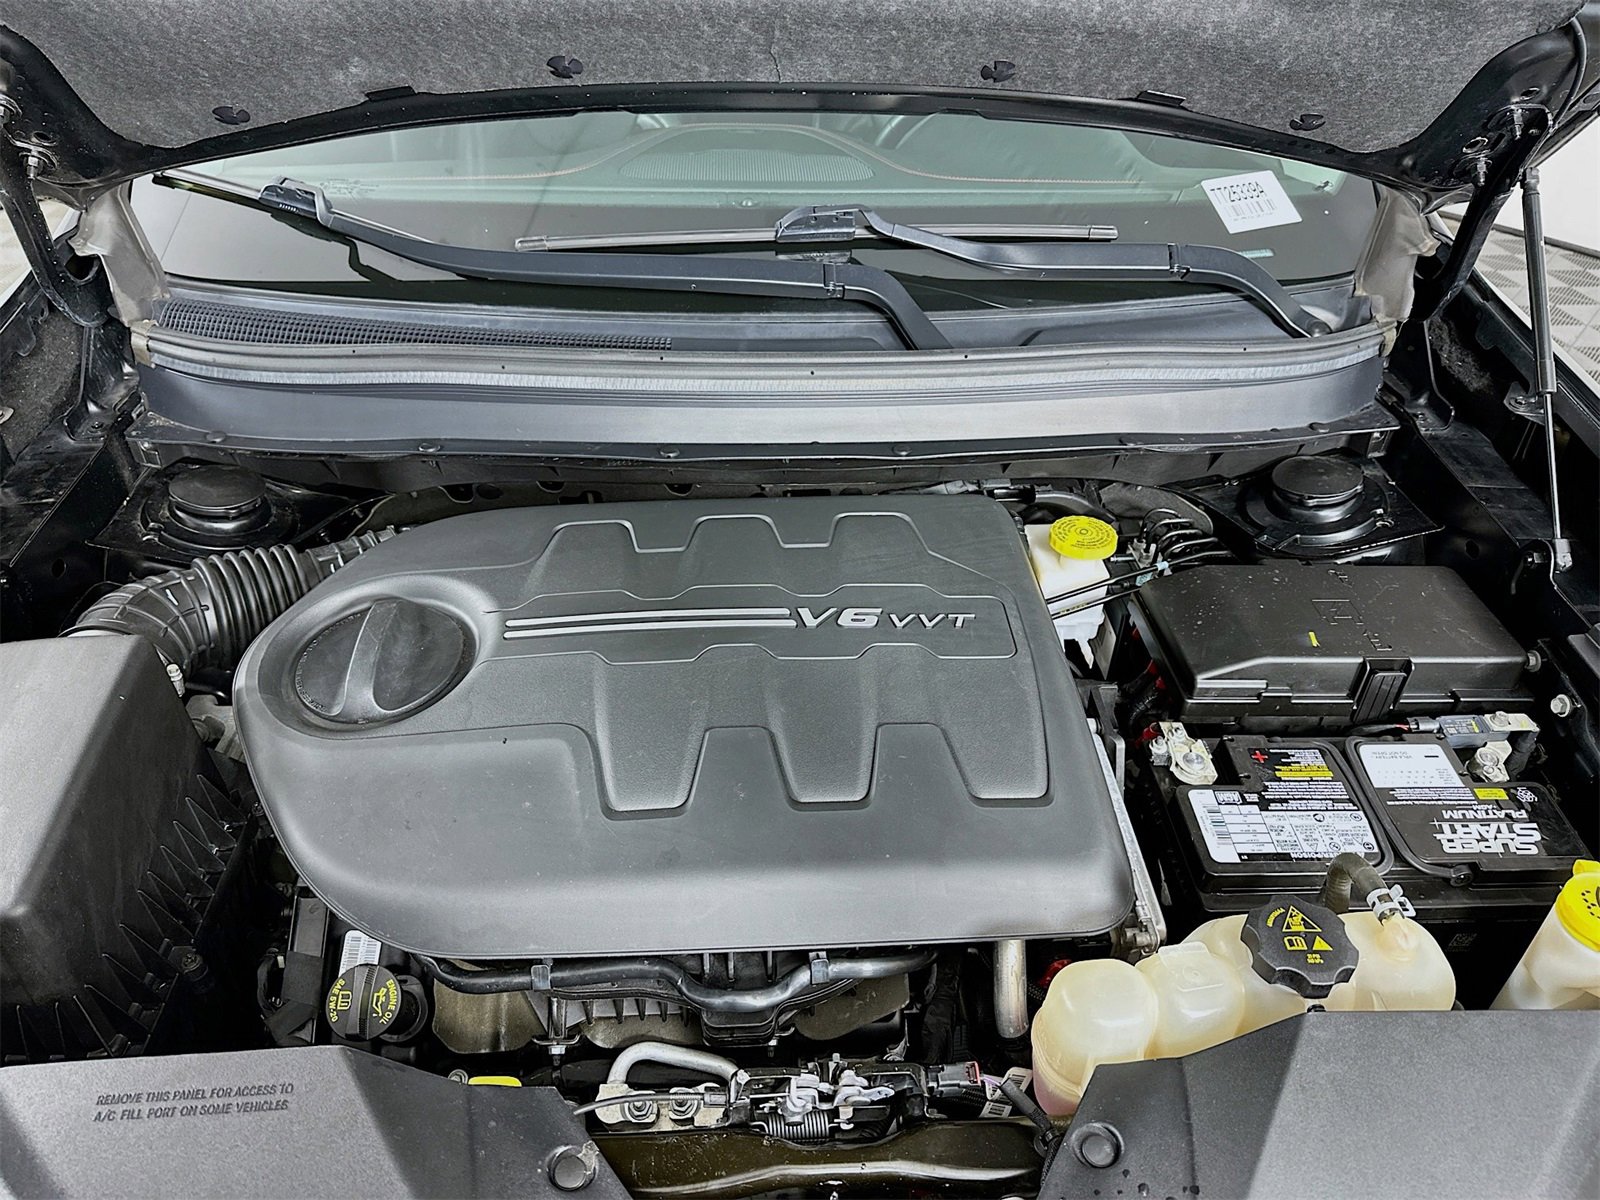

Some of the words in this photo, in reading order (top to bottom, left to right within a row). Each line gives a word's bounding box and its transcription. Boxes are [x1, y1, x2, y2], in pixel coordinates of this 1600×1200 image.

[794, 606, 883, 630] V6
[888, 613, 976, 629] VVT
[1442, 809, 1528, 818] PLATINUM
[1433, 822, 1541, 843] START
[1440, 839, 1538, 855] SUPER
[332, 978, 346, 996] SAE
[386, 979, 398, 1011] ENGINE
[379, 1011, 393, 1025] OIL
[96, 1092, 143, 1106] REMOVE
[146, 1091, 170, 1103] THIS
[172, 1089, 207, 1101] PANEL
[210, 1087, 233, 1098] FOR
[233, 1084, 277, 1097] ACCESS
[279, 1083, 294, 1094] TO
[92, 1110, 115, 1122] A/C
[120, 1108, 143, 1120] FILL
[147, 1107, 176, 1119] PORT
[180, 1105, 199, 1117] ON
[199, 1103, 232, 1115] SOME
[235, 1099, 289, 1114] VEHICLES
